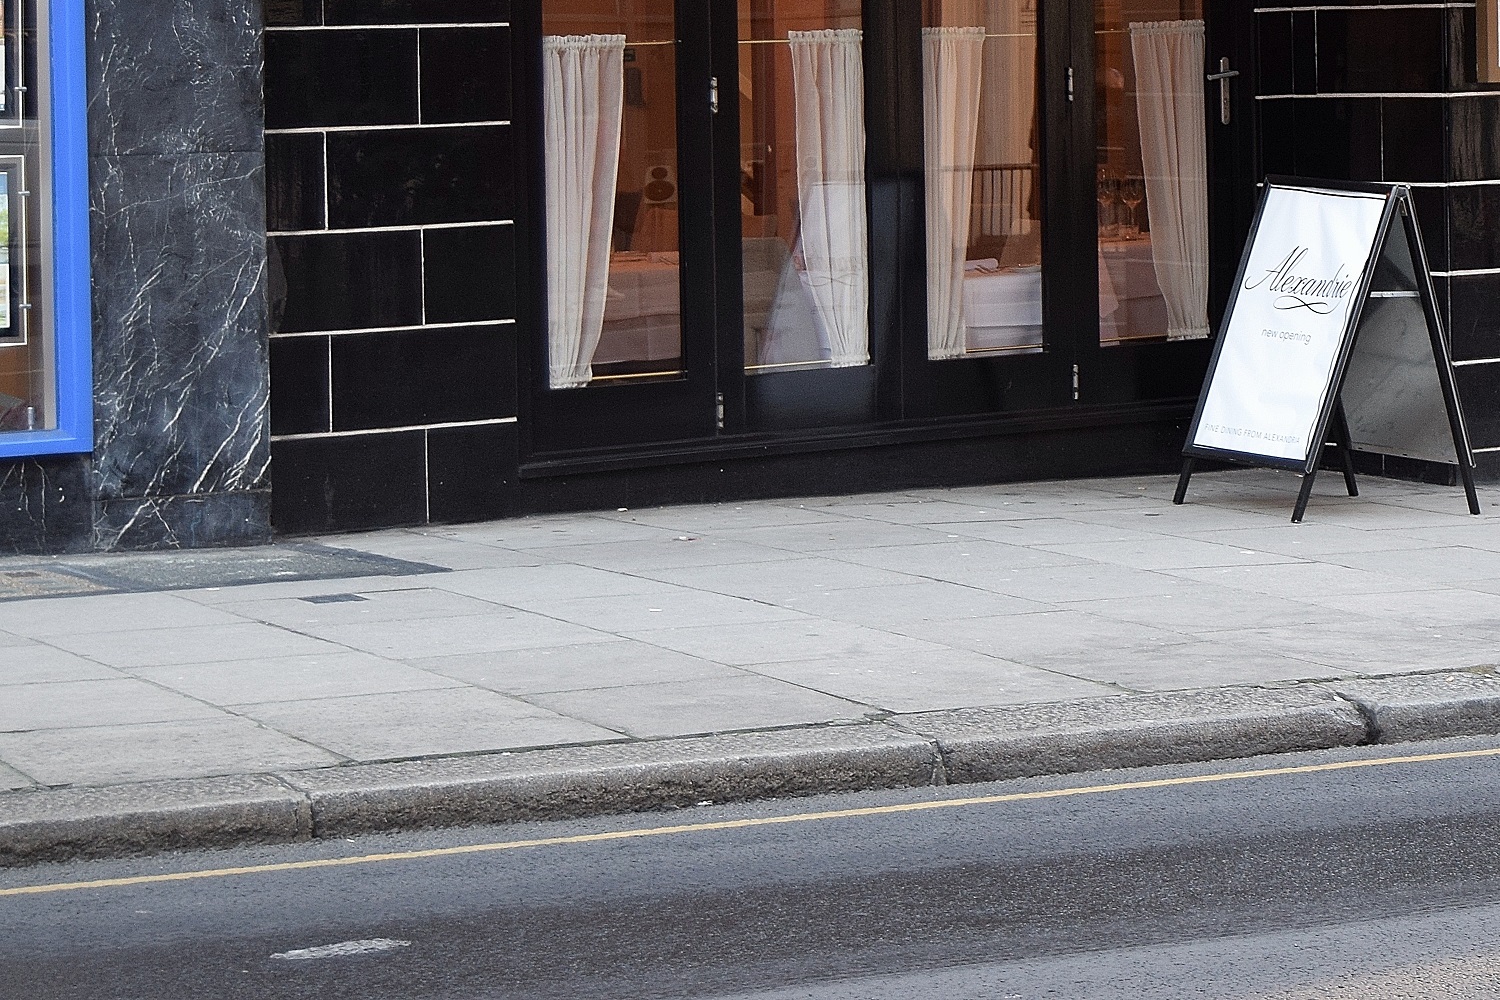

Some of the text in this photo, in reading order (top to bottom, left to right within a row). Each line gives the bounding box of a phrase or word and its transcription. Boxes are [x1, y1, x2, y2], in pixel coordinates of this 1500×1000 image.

[1244, 246, 1352, 315] Alexandrie
[1261, 328, 1312, 346] new opening
[1204, 423, 1220, 433] FINE
[1220, 426, 1243, 437] DINING
[1243, 429, 1262, 439] FROM
